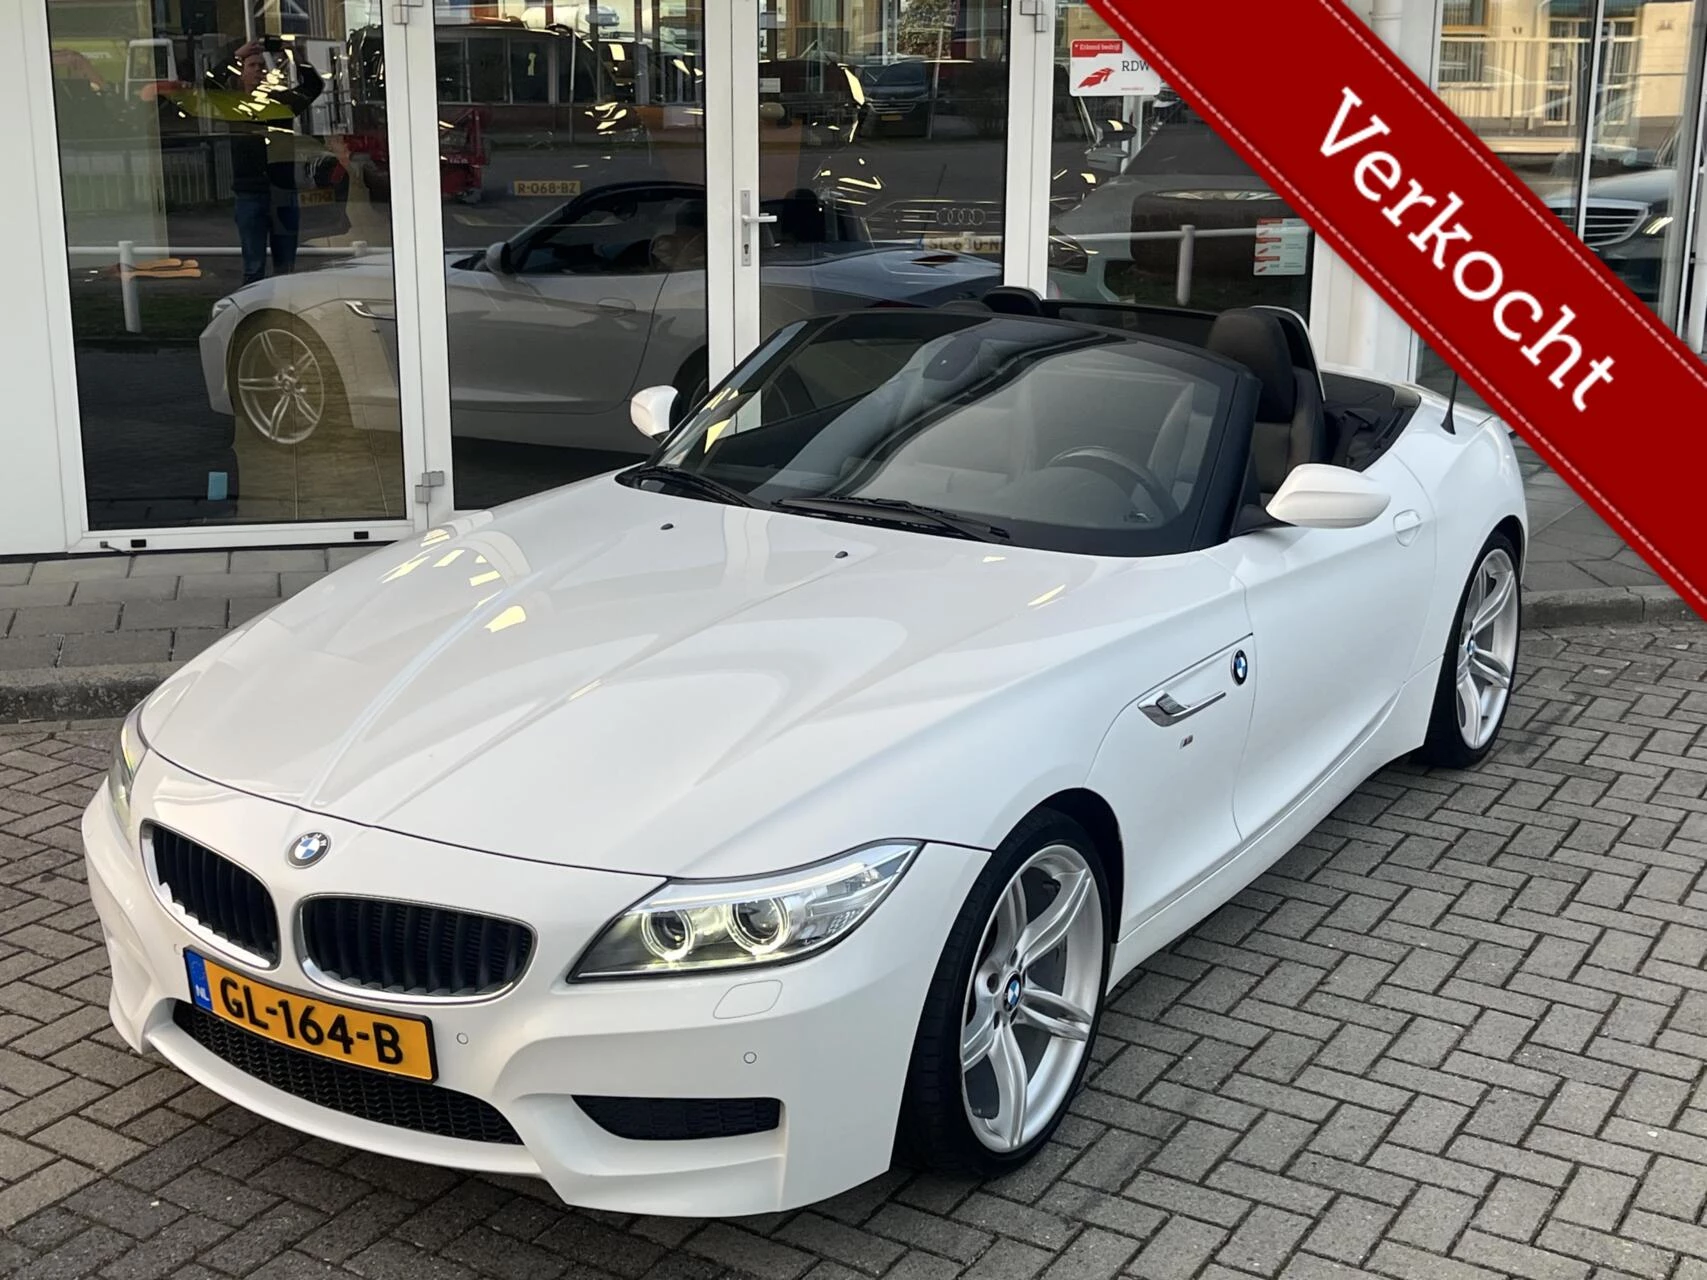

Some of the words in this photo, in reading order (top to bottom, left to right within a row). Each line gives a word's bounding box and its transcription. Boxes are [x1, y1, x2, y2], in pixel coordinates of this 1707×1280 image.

[1121, 60, 1149, 72] RDW
[195, 984, 210, 1001] NL
[220, 976, 404, 1065] GL-164-B
